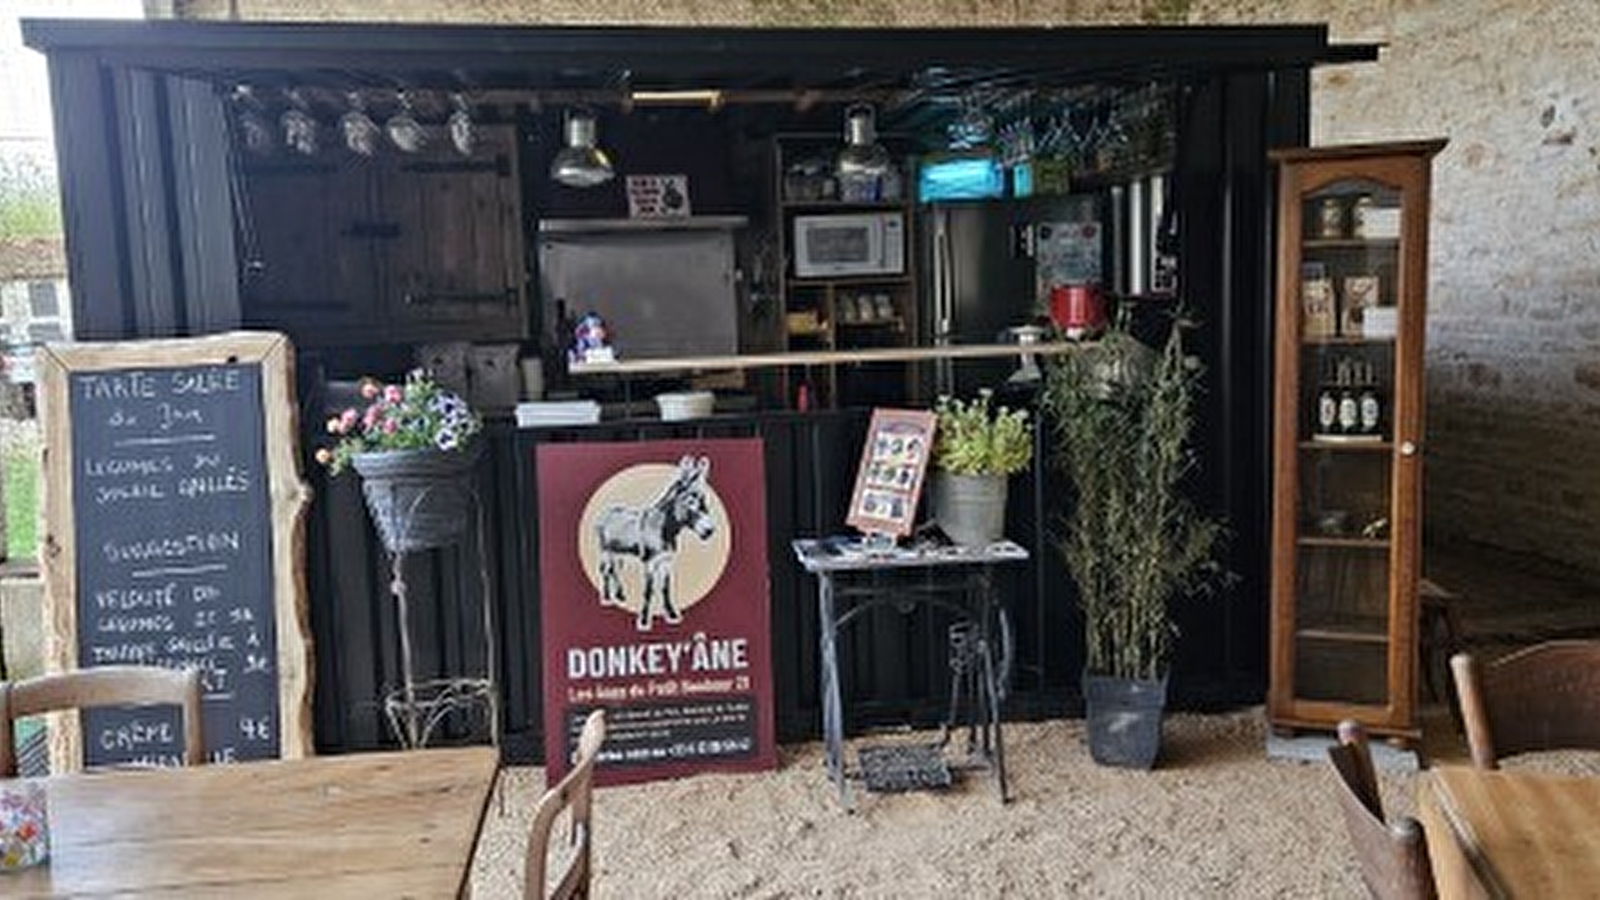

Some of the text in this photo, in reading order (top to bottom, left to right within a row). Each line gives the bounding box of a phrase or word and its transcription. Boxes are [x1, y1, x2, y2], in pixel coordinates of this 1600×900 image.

[80, 371, 156, 399] TARTE
[567, 632, 748, 678] DONKEY'ÂNE
[567, 687, 593, 703] Les
